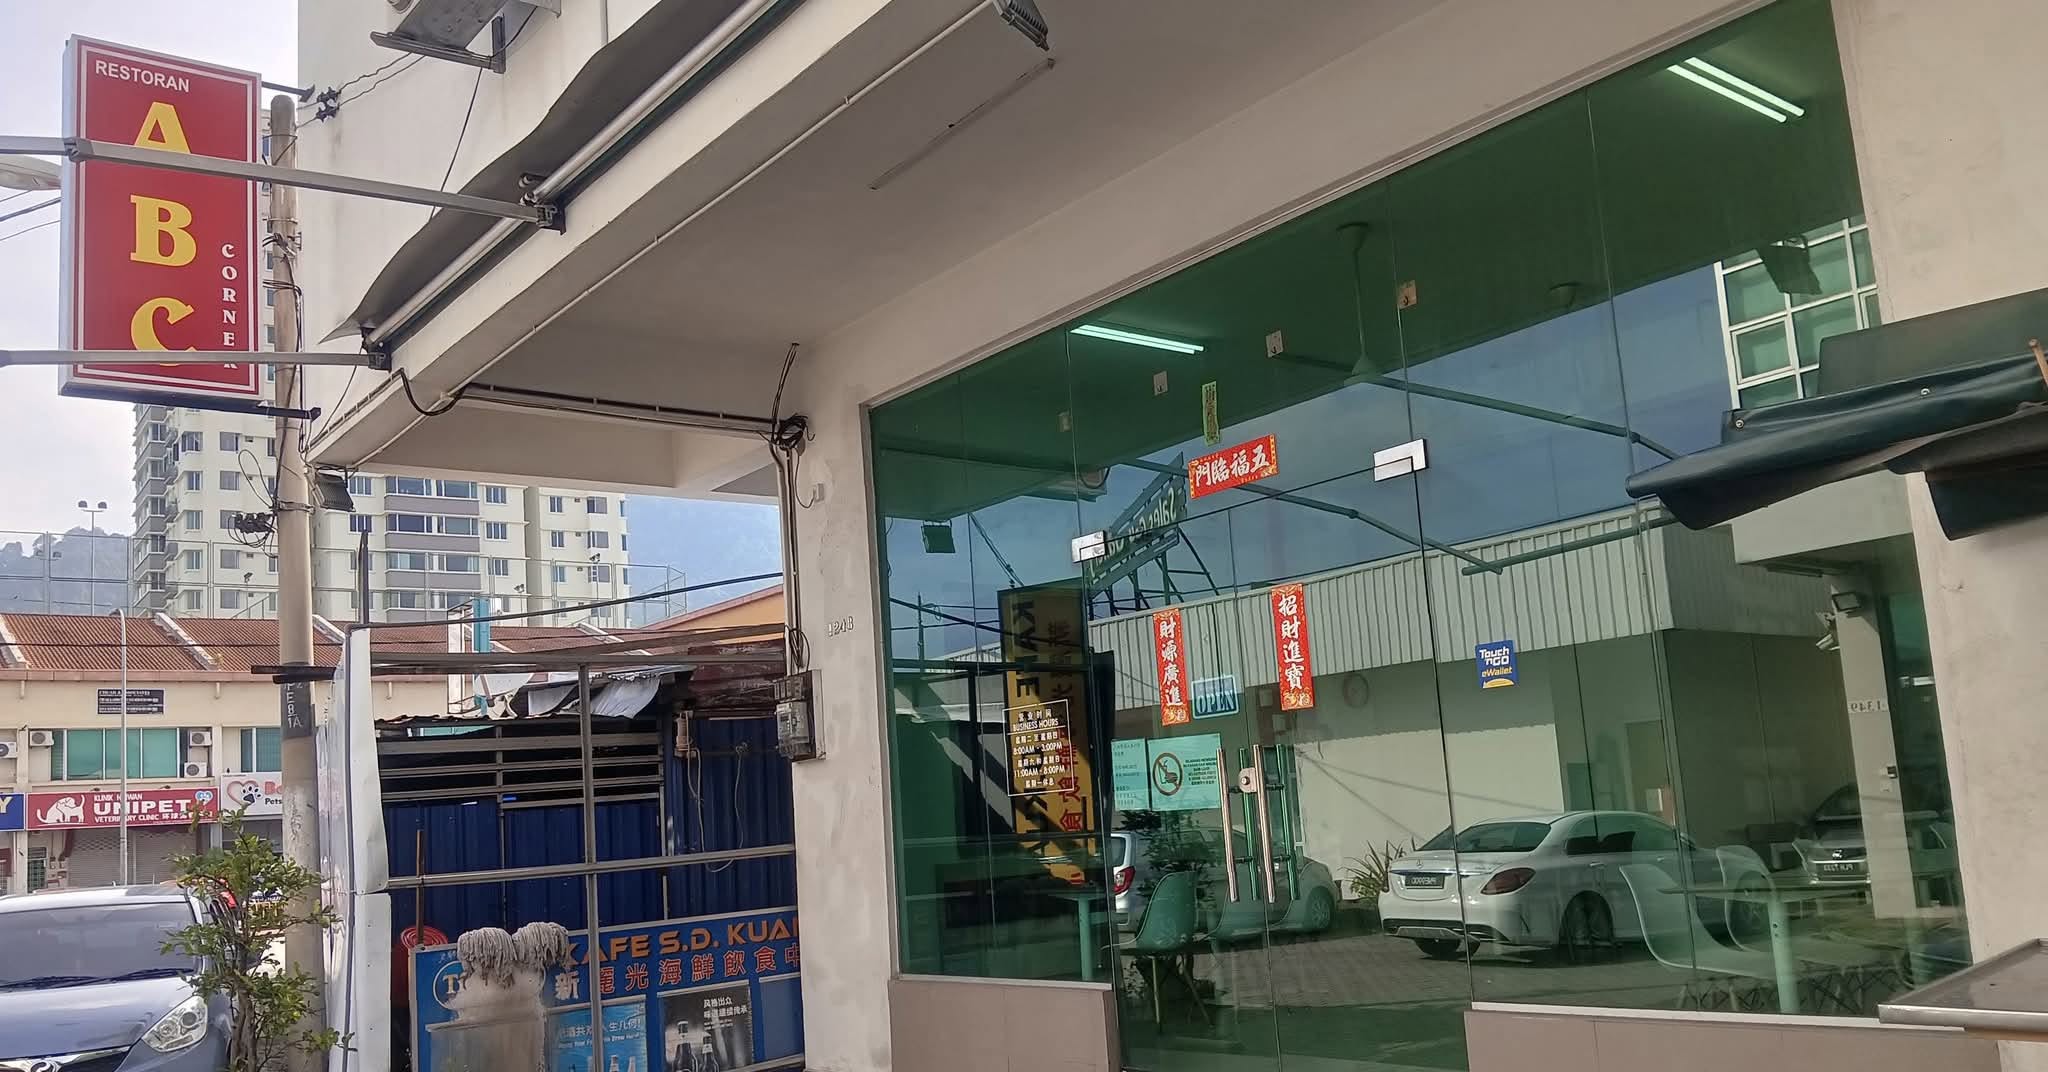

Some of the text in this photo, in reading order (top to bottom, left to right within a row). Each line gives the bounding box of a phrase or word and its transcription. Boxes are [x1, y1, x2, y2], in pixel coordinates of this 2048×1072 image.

[95, 60, 190, 93] RESTORAN
[221, 243, 239, 369] CORNE
[1278, 594, 1305, 690] 招財進寶
[1160, 616, 1184, 706] 財源廣進
[1479, 646, 1510, 659] Touch
[1481, 666, 1513, 678] eWallet
[1196, 690, 1235, 713] OPEN
[1013, 718, 1059, 732] BUSINESS HOURS
[1014, 767, 1039, 777] 11:00AM
[1043, 764, 1066, 775] 8:00PM
[116, 793, 143, 801] HWAN
[94, 800, 191, 815] UNIPET
[659, 927, 720, 955] S.D.
[727, 914, 799, 947] KUA
